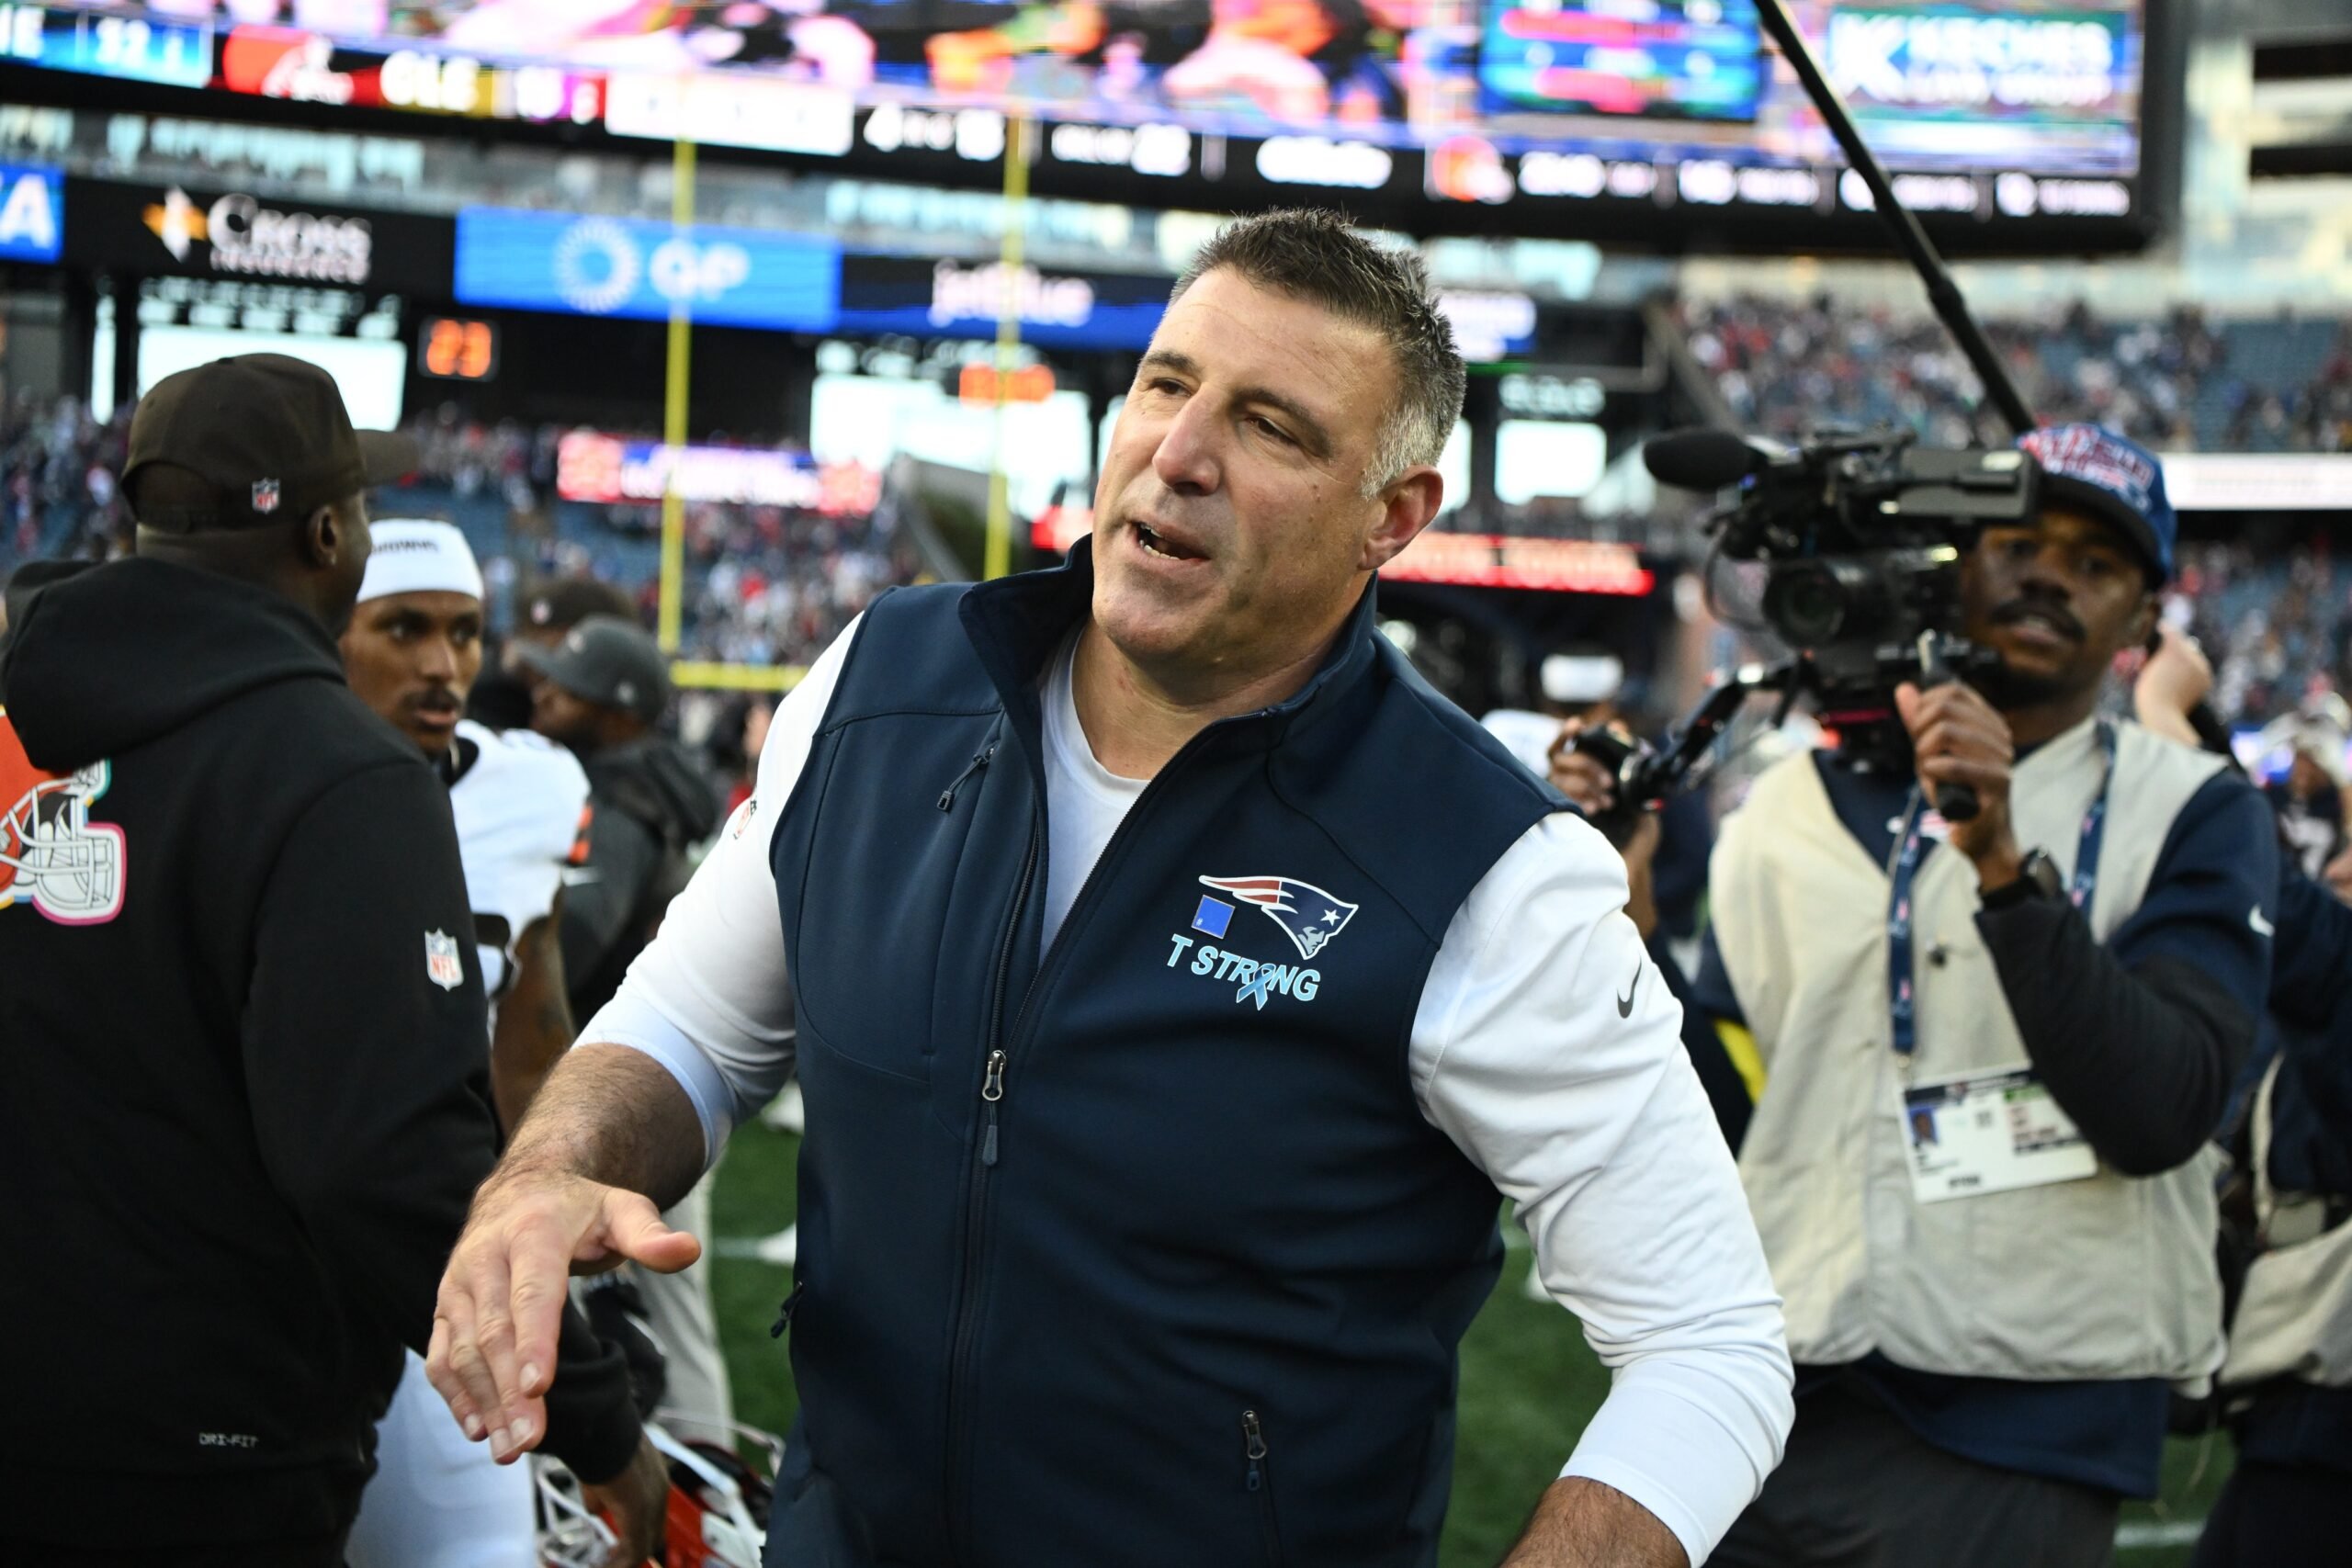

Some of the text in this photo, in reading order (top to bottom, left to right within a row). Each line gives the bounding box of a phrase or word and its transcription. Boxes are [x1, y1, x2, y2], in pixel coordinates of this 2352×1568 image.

[1166, 932, 1194, 968] T
[429, 953, 458, 981] NFL
[198, 1432, 259, 1449] DRI-FIT
